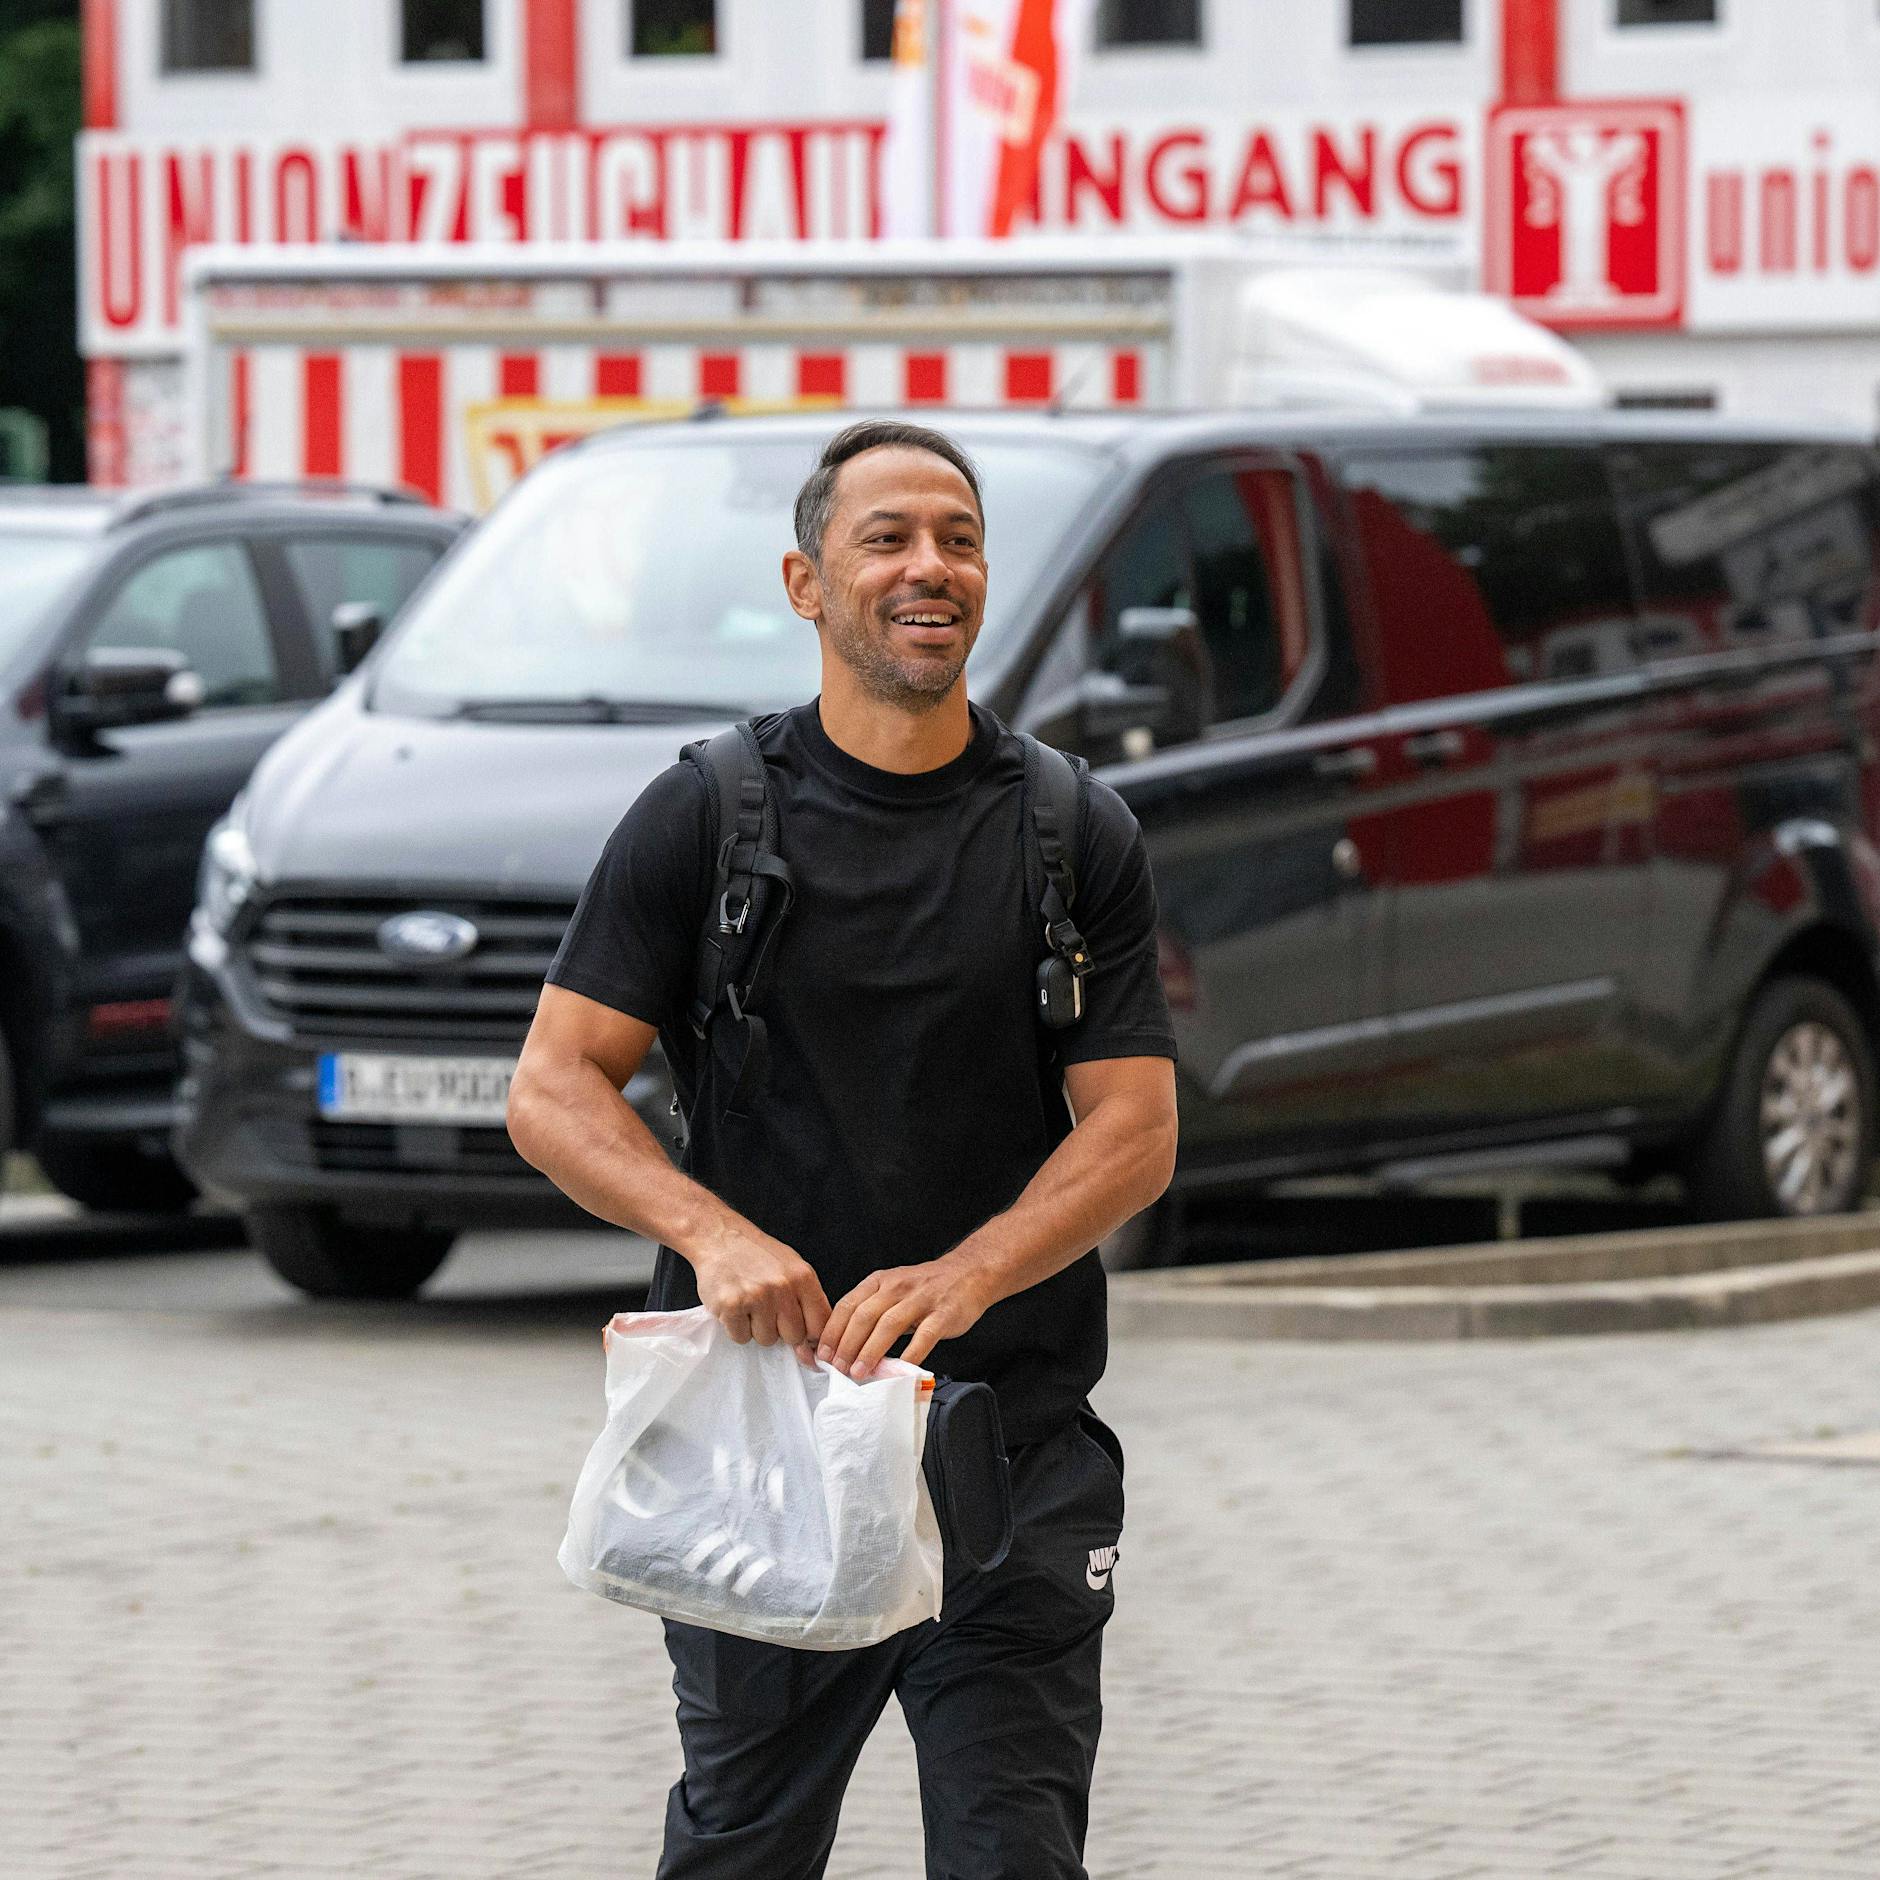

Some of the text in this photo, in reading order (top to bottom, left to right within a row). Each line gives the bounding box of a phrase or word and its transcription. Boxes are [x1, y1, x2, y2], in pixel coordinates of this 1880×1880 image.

[1028, 125, 1464, 224] INGANG
[95, 131, 880, 327] UNIONZEUGHAU
[1088, 1545, 1119, 1573] NIK
